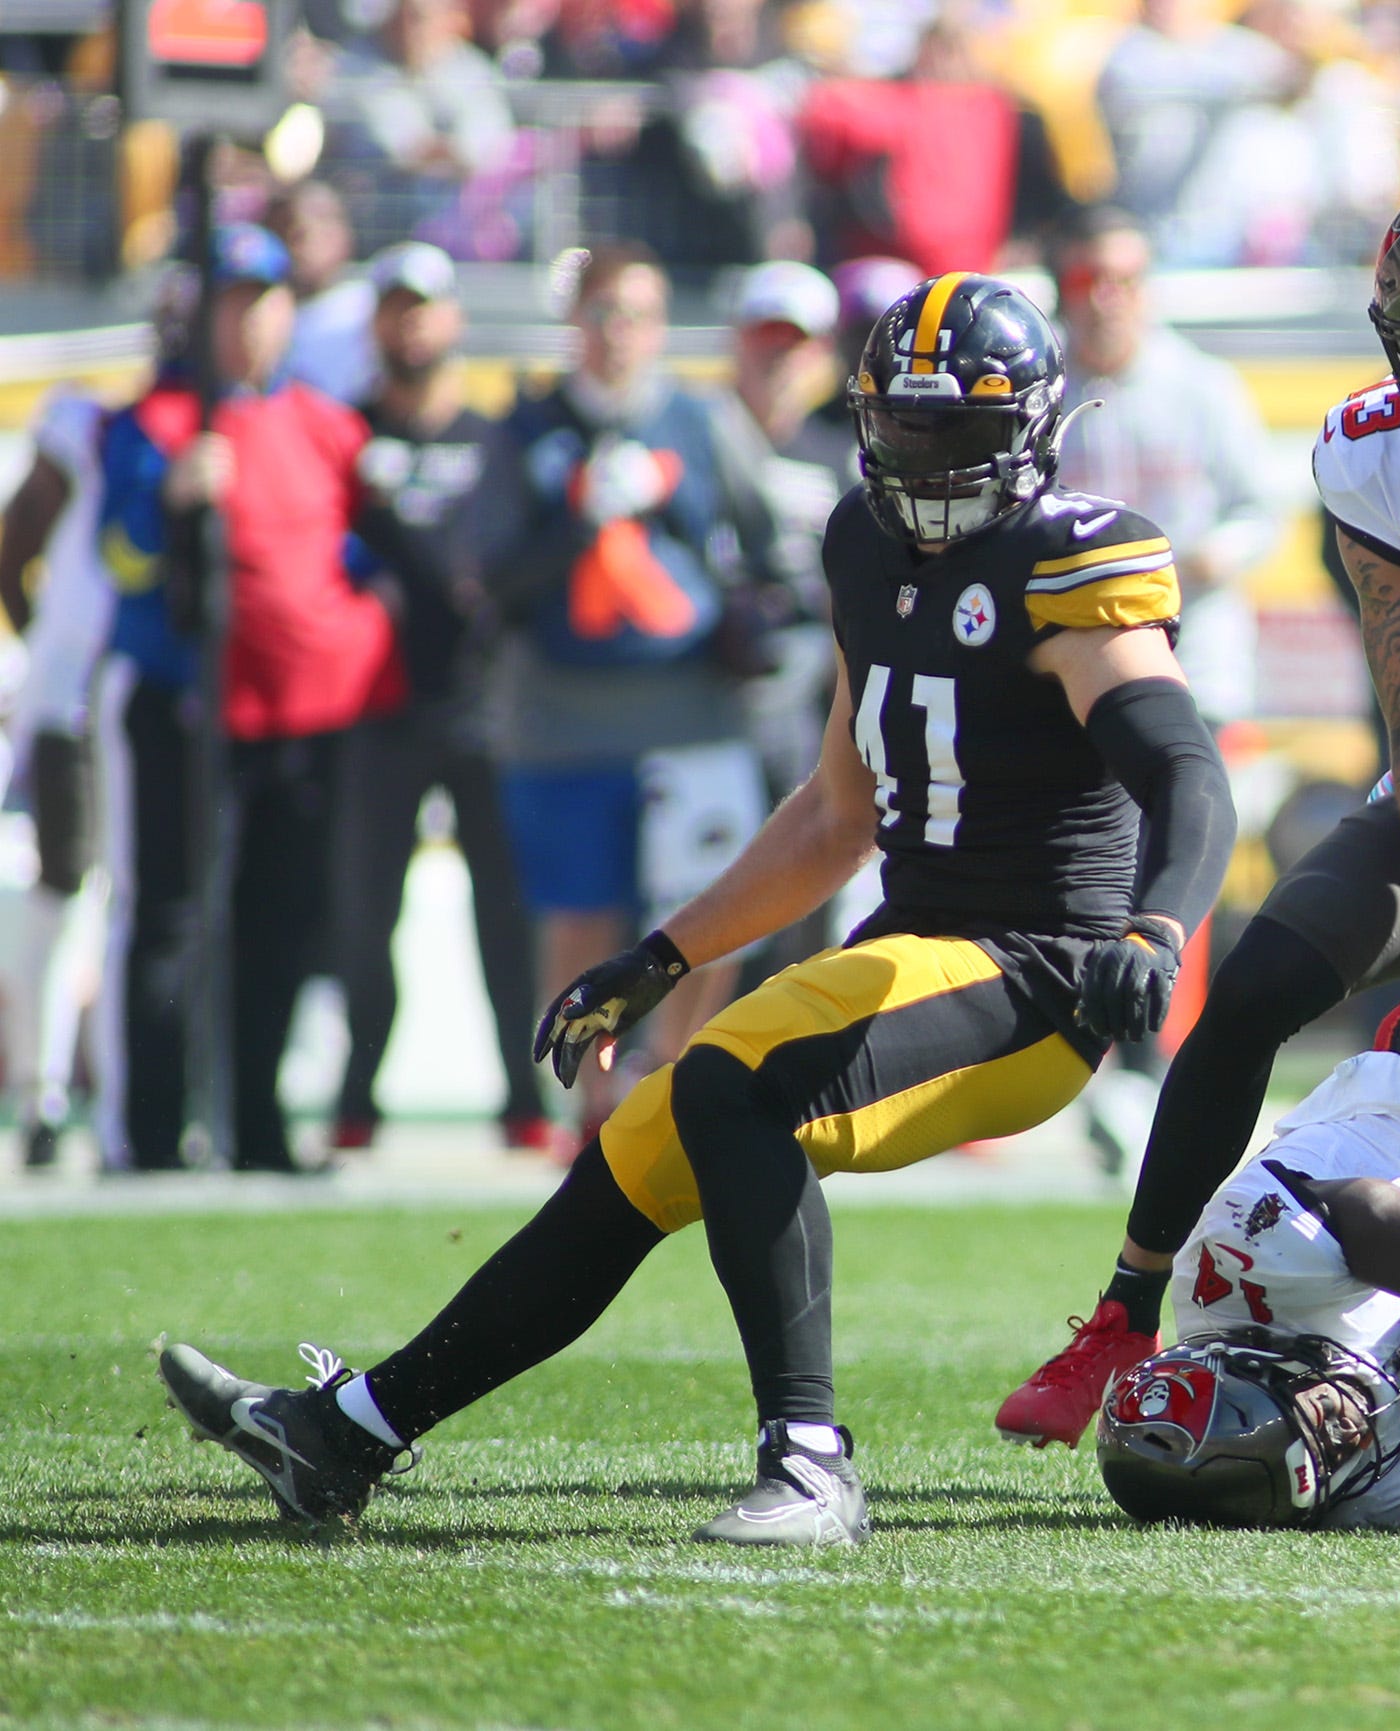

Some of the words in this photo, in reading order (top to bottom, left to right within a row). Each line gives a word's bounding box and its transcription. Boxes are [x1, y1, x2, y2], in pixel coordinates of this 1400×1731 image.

[892, 328, 953, 373] 41
[903, 376, 940, 389] Steelers
[854, 664, 966, 847] 41
